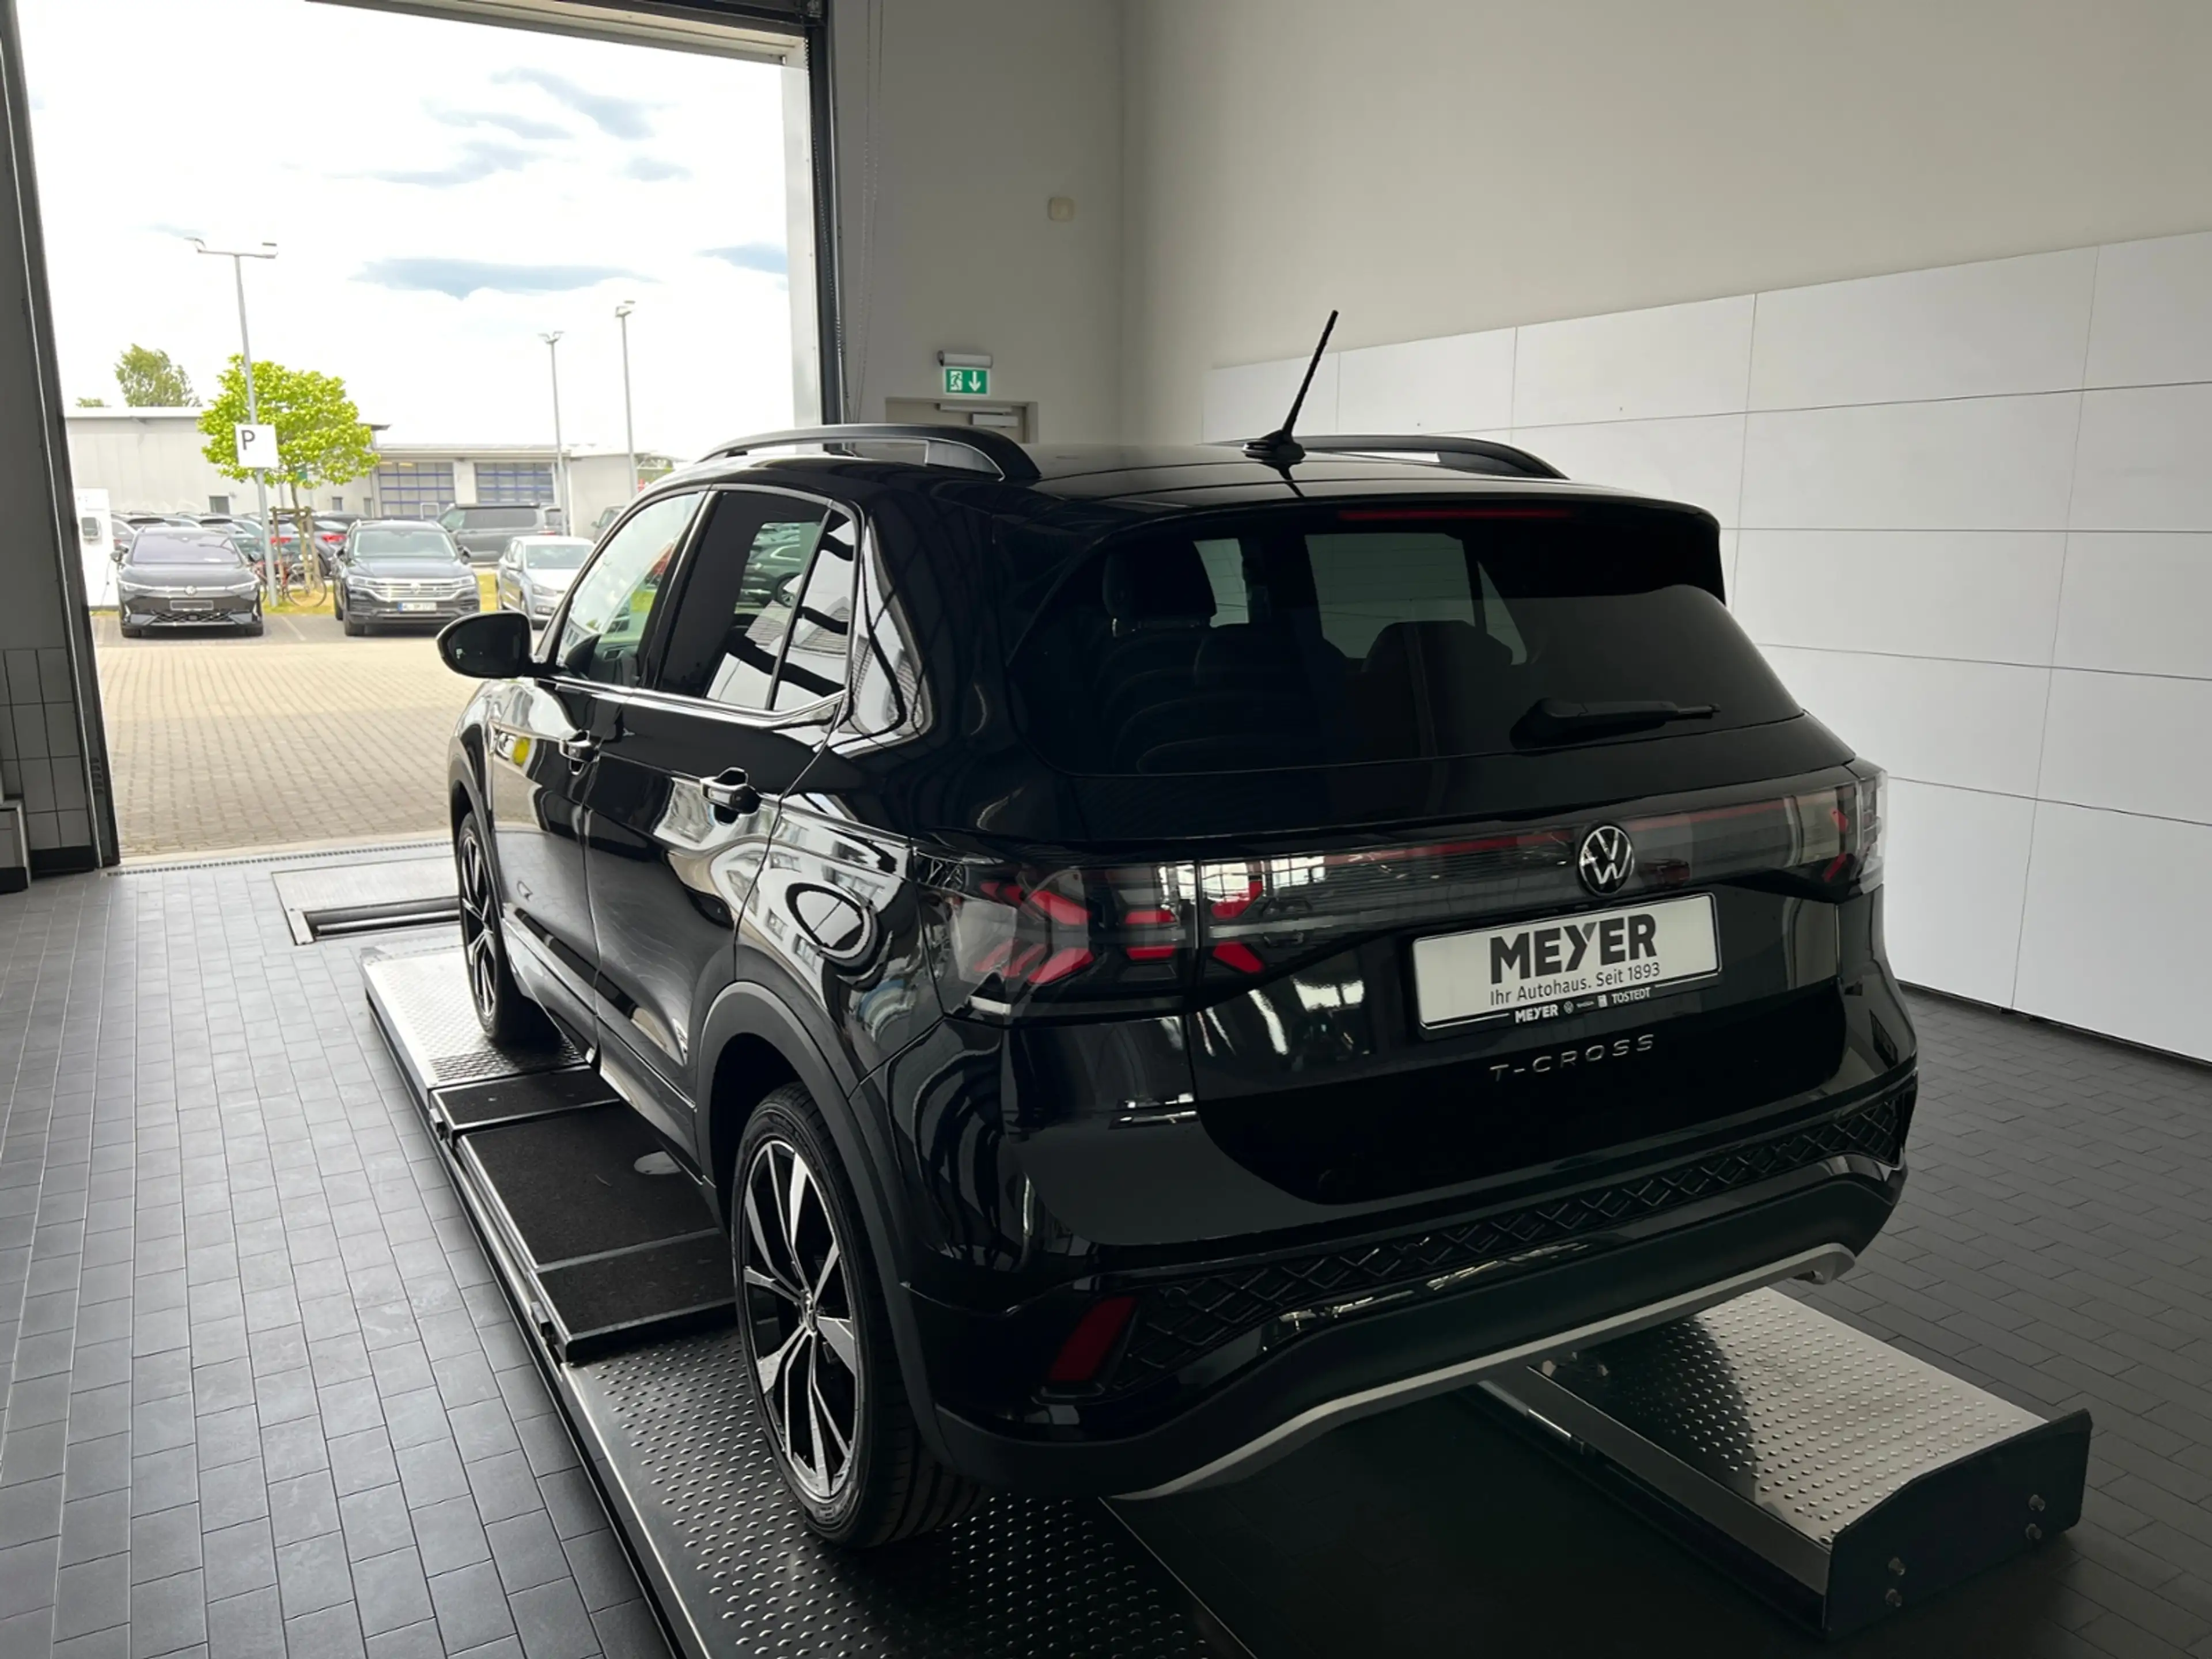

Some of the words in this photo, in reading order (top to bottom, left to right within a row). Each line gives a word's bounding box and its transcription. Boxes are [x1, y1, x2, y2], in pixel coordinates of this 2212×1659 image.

[241, 430, 255, 450] P
[1490, 913, 1657, 984] MEYER
[1491, 989, 1512, 1006] Ihr
[1517, 978, 1592, 1001] Autohaus.
[1596, 967, 1623, 987] Seit
[1628, 962, 1660, 981] 1893
[1515, 1005, 1559, 1023] MEYER
[1612, 987, 1652, 1005] TOSTEDT
[1490, 1034, 1654, 1081] T-CROSS
